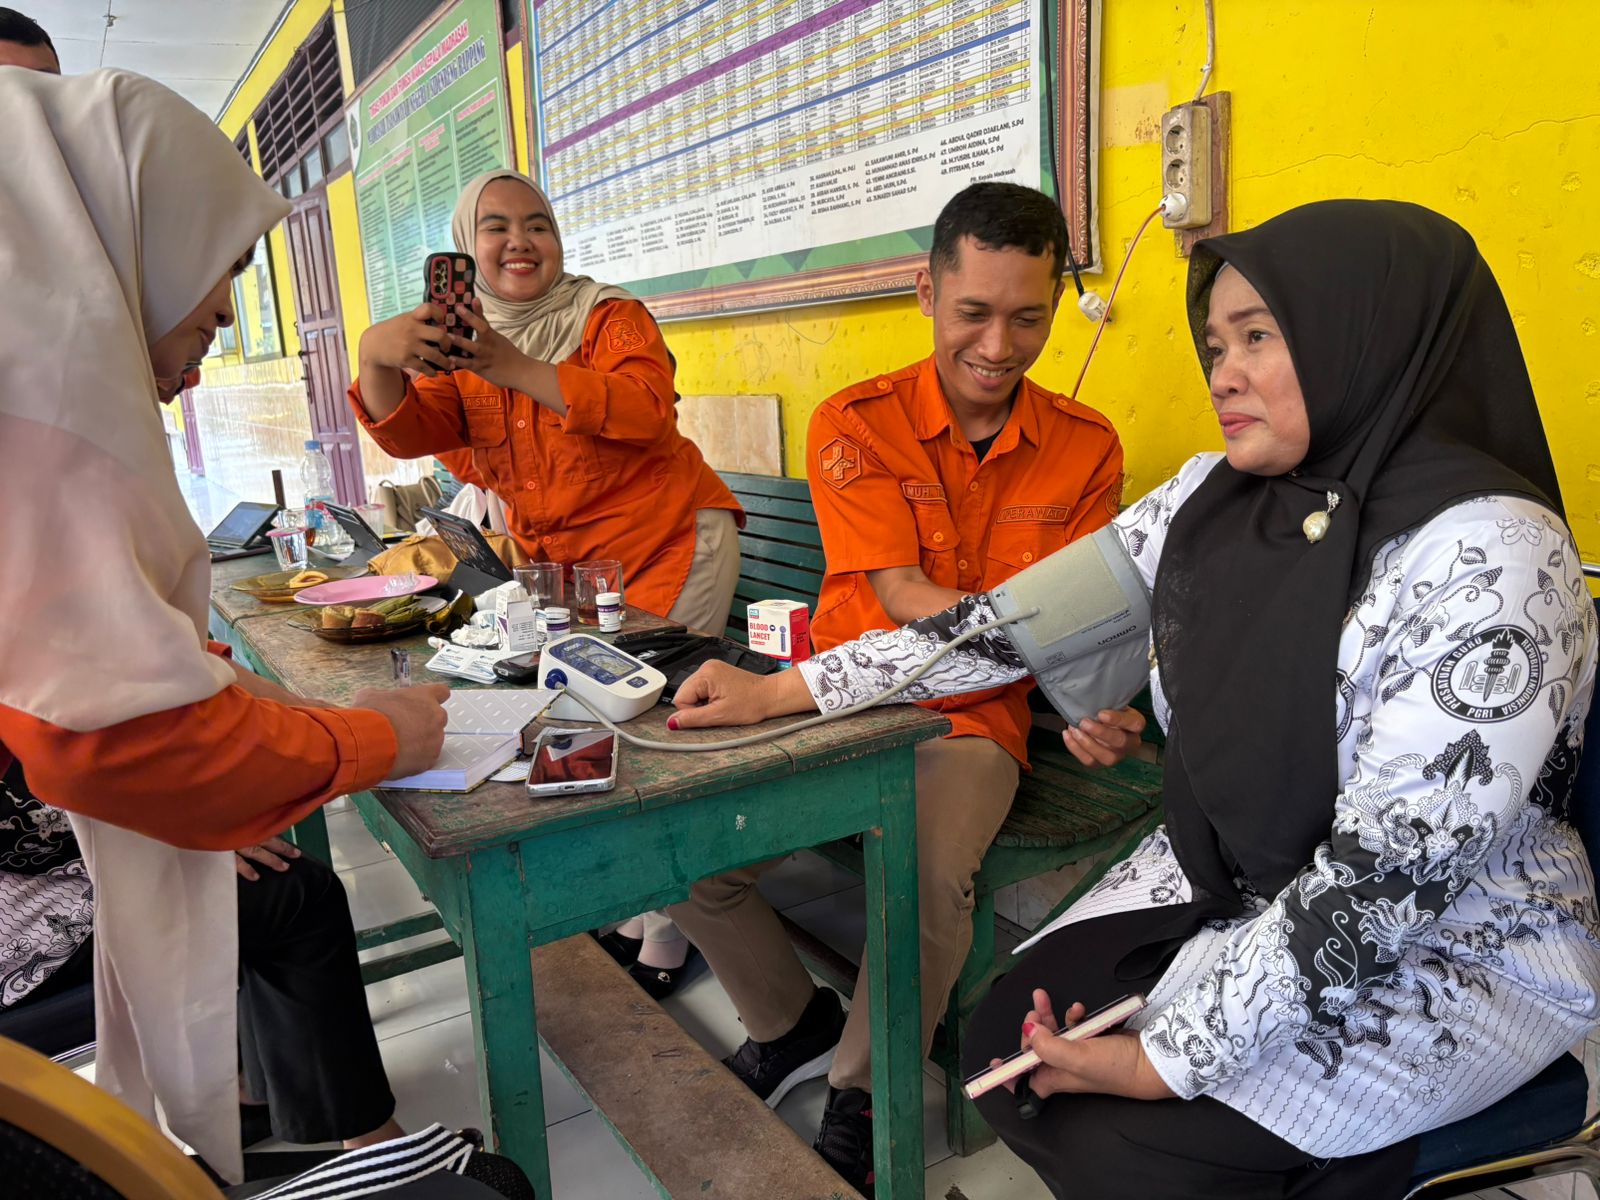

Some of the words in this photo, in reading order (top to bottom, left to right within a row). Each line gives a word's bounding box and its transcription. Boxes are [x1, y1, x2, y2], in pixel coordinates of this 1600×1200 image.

[949, 134, 964, 144] ABDUL
[750, 623, 768, 631] BLOOD
[750, 632, 770, 640] LANCET
[1452, 636, 1482, 658] GURU
[1521, 638, 1539, 678] REPUBLIK
[1438, 660, 1461, 710] PERSATUAN
[1501, 678, 1538, 716] INDONESIA
[1466, 707, 1493, 718] PGRI
